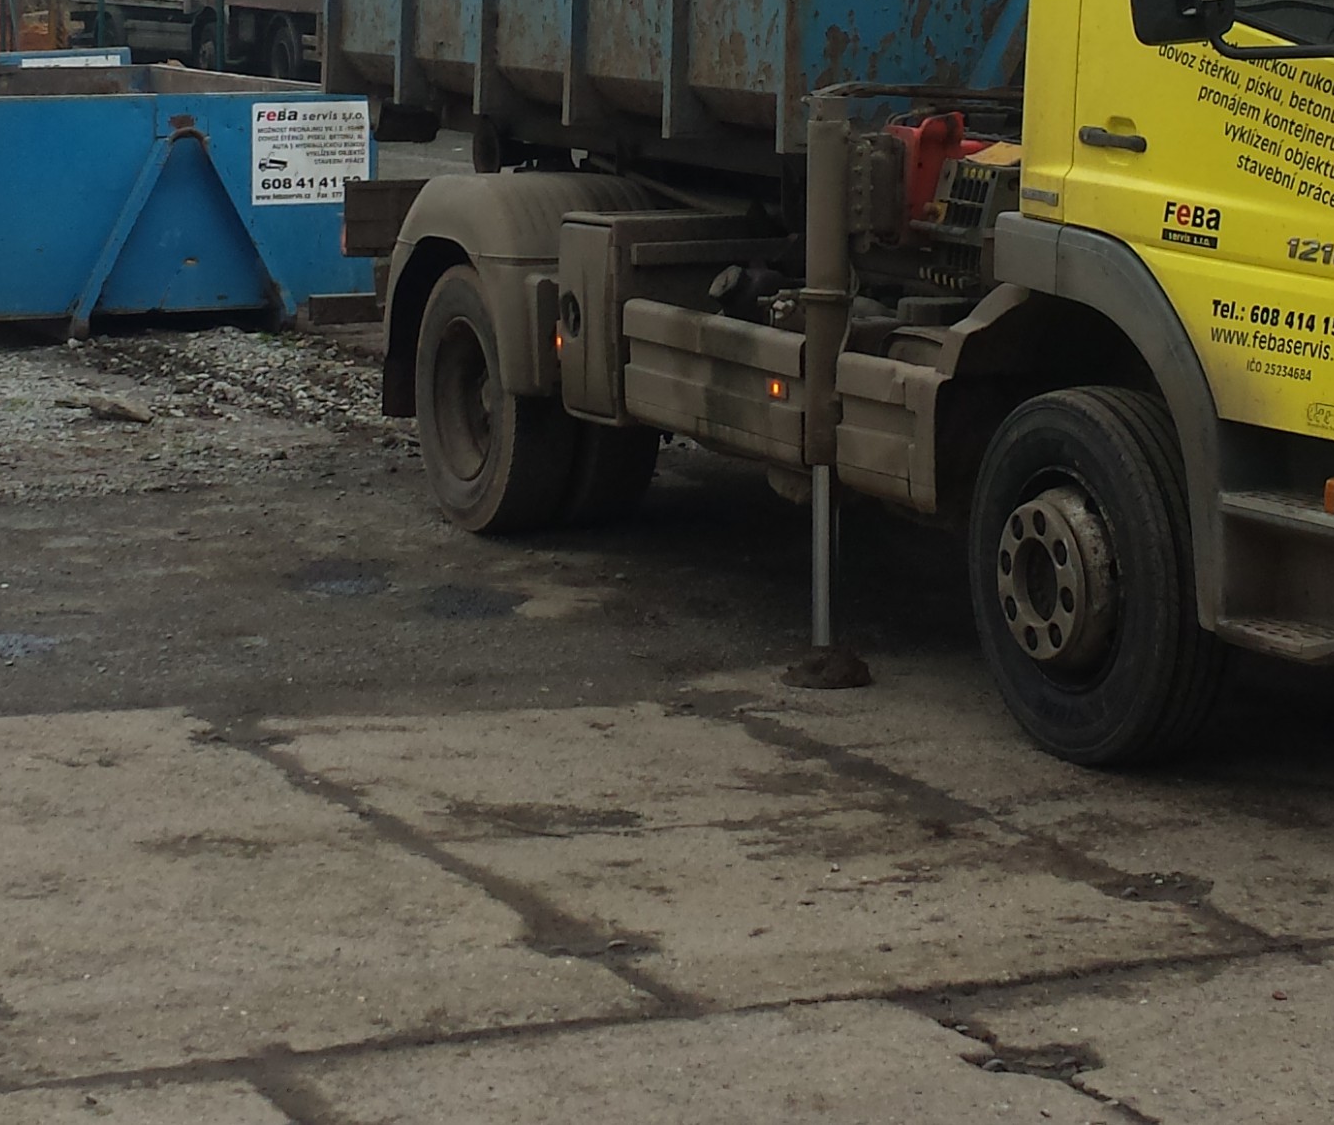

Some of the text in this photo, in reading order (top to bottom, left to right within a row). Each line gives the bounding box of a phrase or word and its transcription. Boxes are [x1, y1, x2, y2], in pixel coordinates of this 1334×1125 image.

[1158, 44, 1197, 69] dovoz
[1198, 54, 1242, 89] štěrku,
[1245, 75, 1284, 106] písku,
[256, 110, 298, 122] FeBa
[302, 111, 338, 121] servis
[1198, 85, 1261, 122] pronájem
[1225, 122, 1285, 157] vyklízení
[261, 178, 292, 190] 608
[296, 177, 314, 189] 41
[319, 176, 337, 188] 41
[1237, 154, 1298, 191] stavební
[1163, 201, 1221, 231] FeBa
[1168, 231, 1191, 243] servis
[1212, 299, 1245, 321] Tel.:
[1250, 305, 1280, 326] 608
[1285, 310, 1315, 332] 414
[1246, 358, 1312, 382] IČO 25234684
